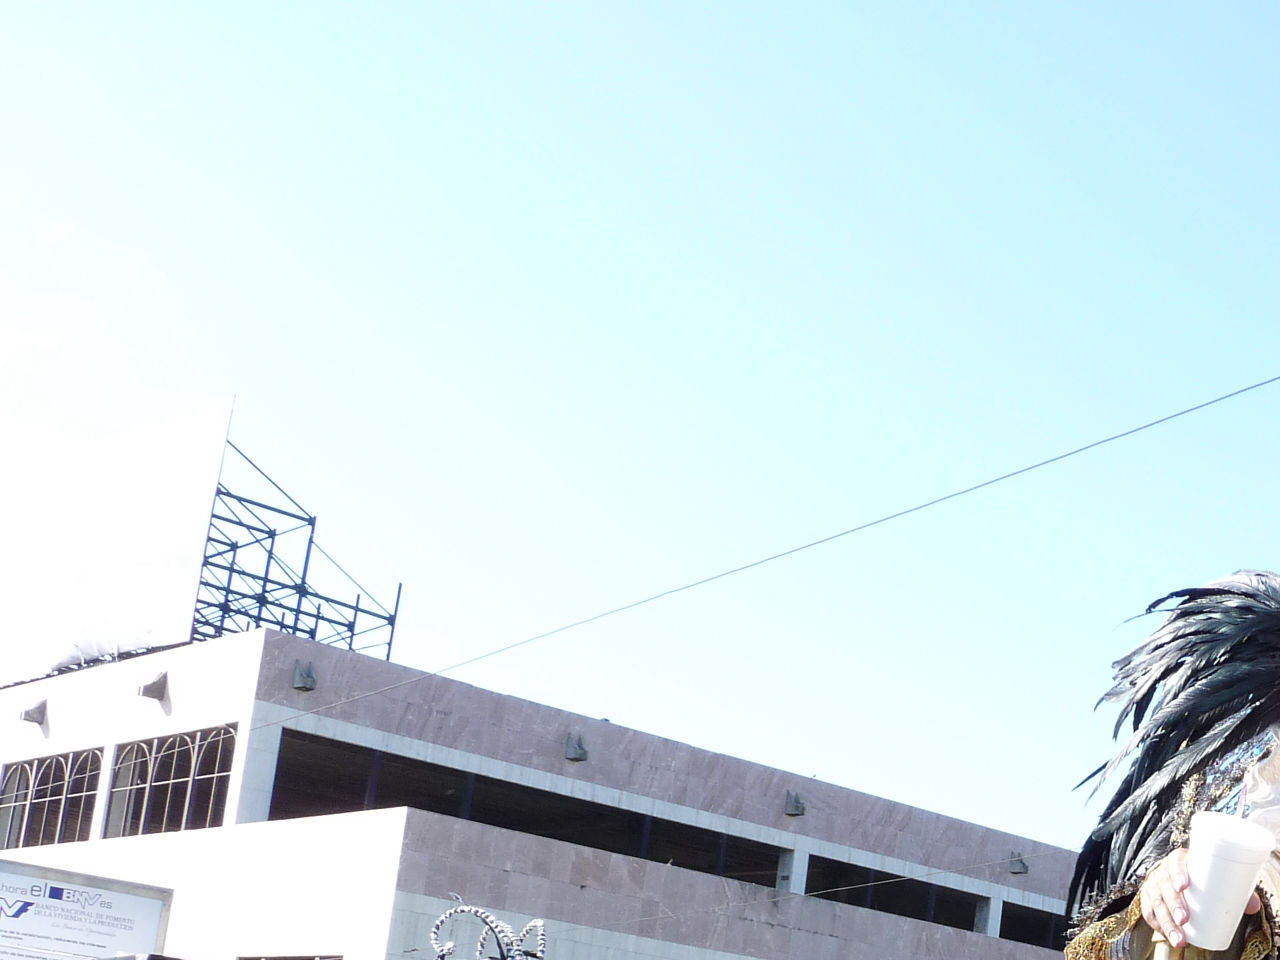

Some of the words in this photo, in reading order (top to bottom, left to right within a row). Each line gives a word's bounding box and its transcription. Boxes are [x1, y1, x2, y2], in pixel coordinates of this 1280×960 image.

[0, 883, 27, 895] hora
[30, 882, 48, 897] el
[100, 900, 113, 909] es
[54, 911, 83, 922] VIVIENDA
[61, 906, 93, 918] NACIONAL
